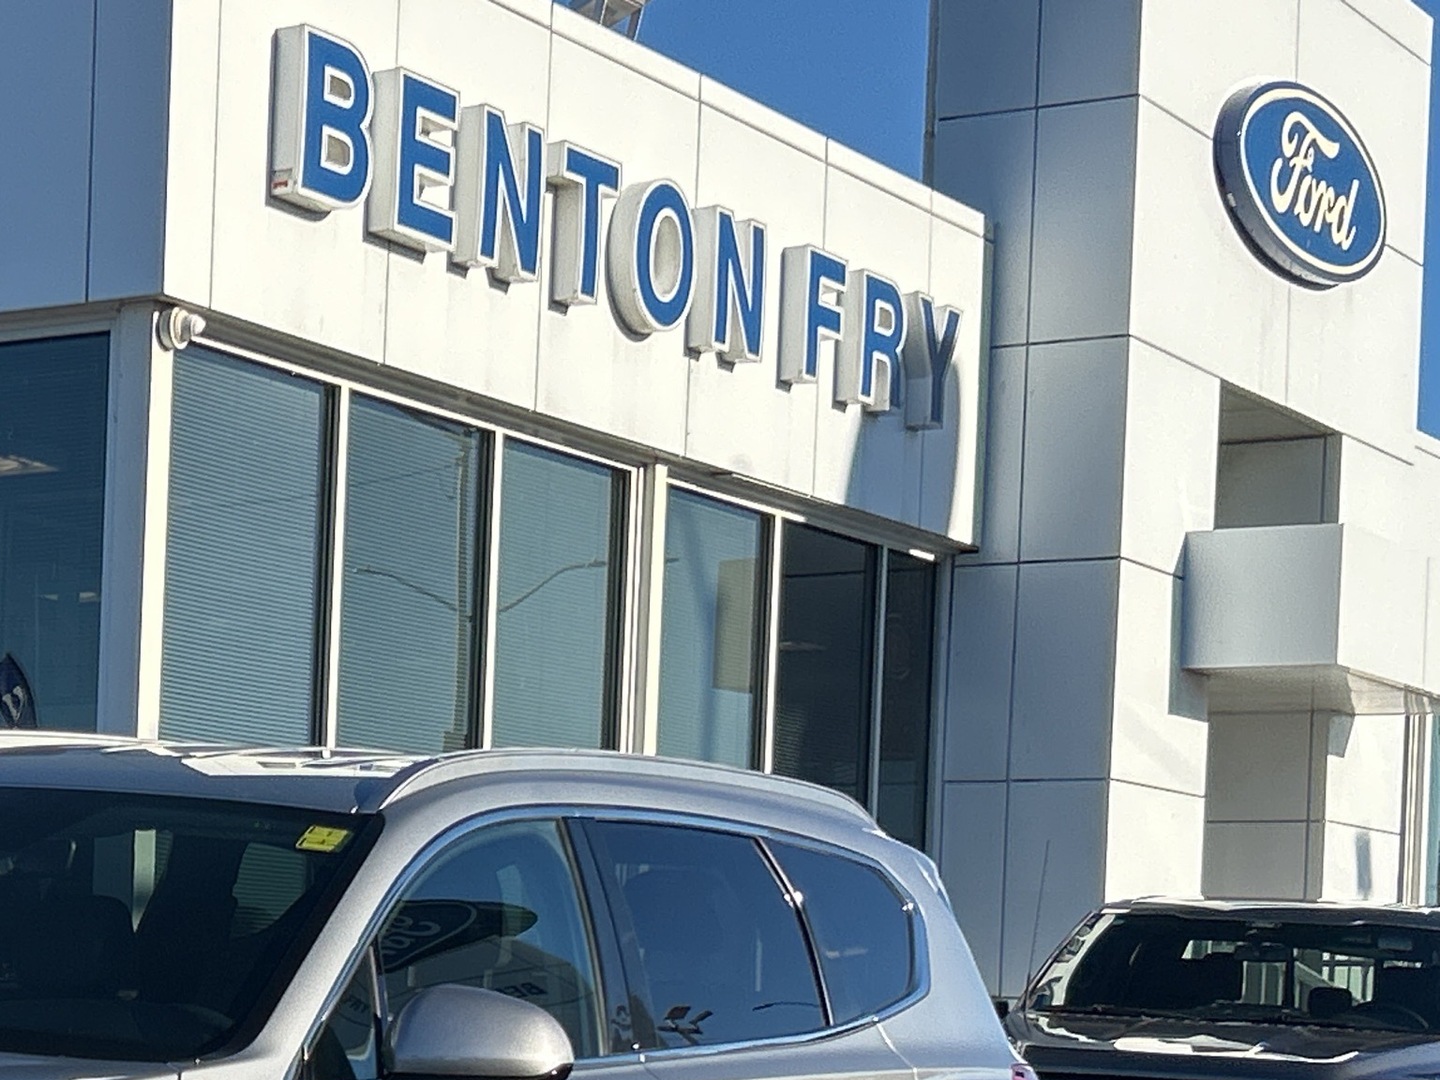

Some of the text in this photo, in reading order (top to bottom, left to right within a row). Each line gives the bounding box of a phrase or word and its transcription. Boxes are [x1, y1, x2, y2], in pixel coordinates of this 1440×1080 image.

[270, 24, 963, 430] BENTON FRY
[1271, 111, 1359, 250] Ford
